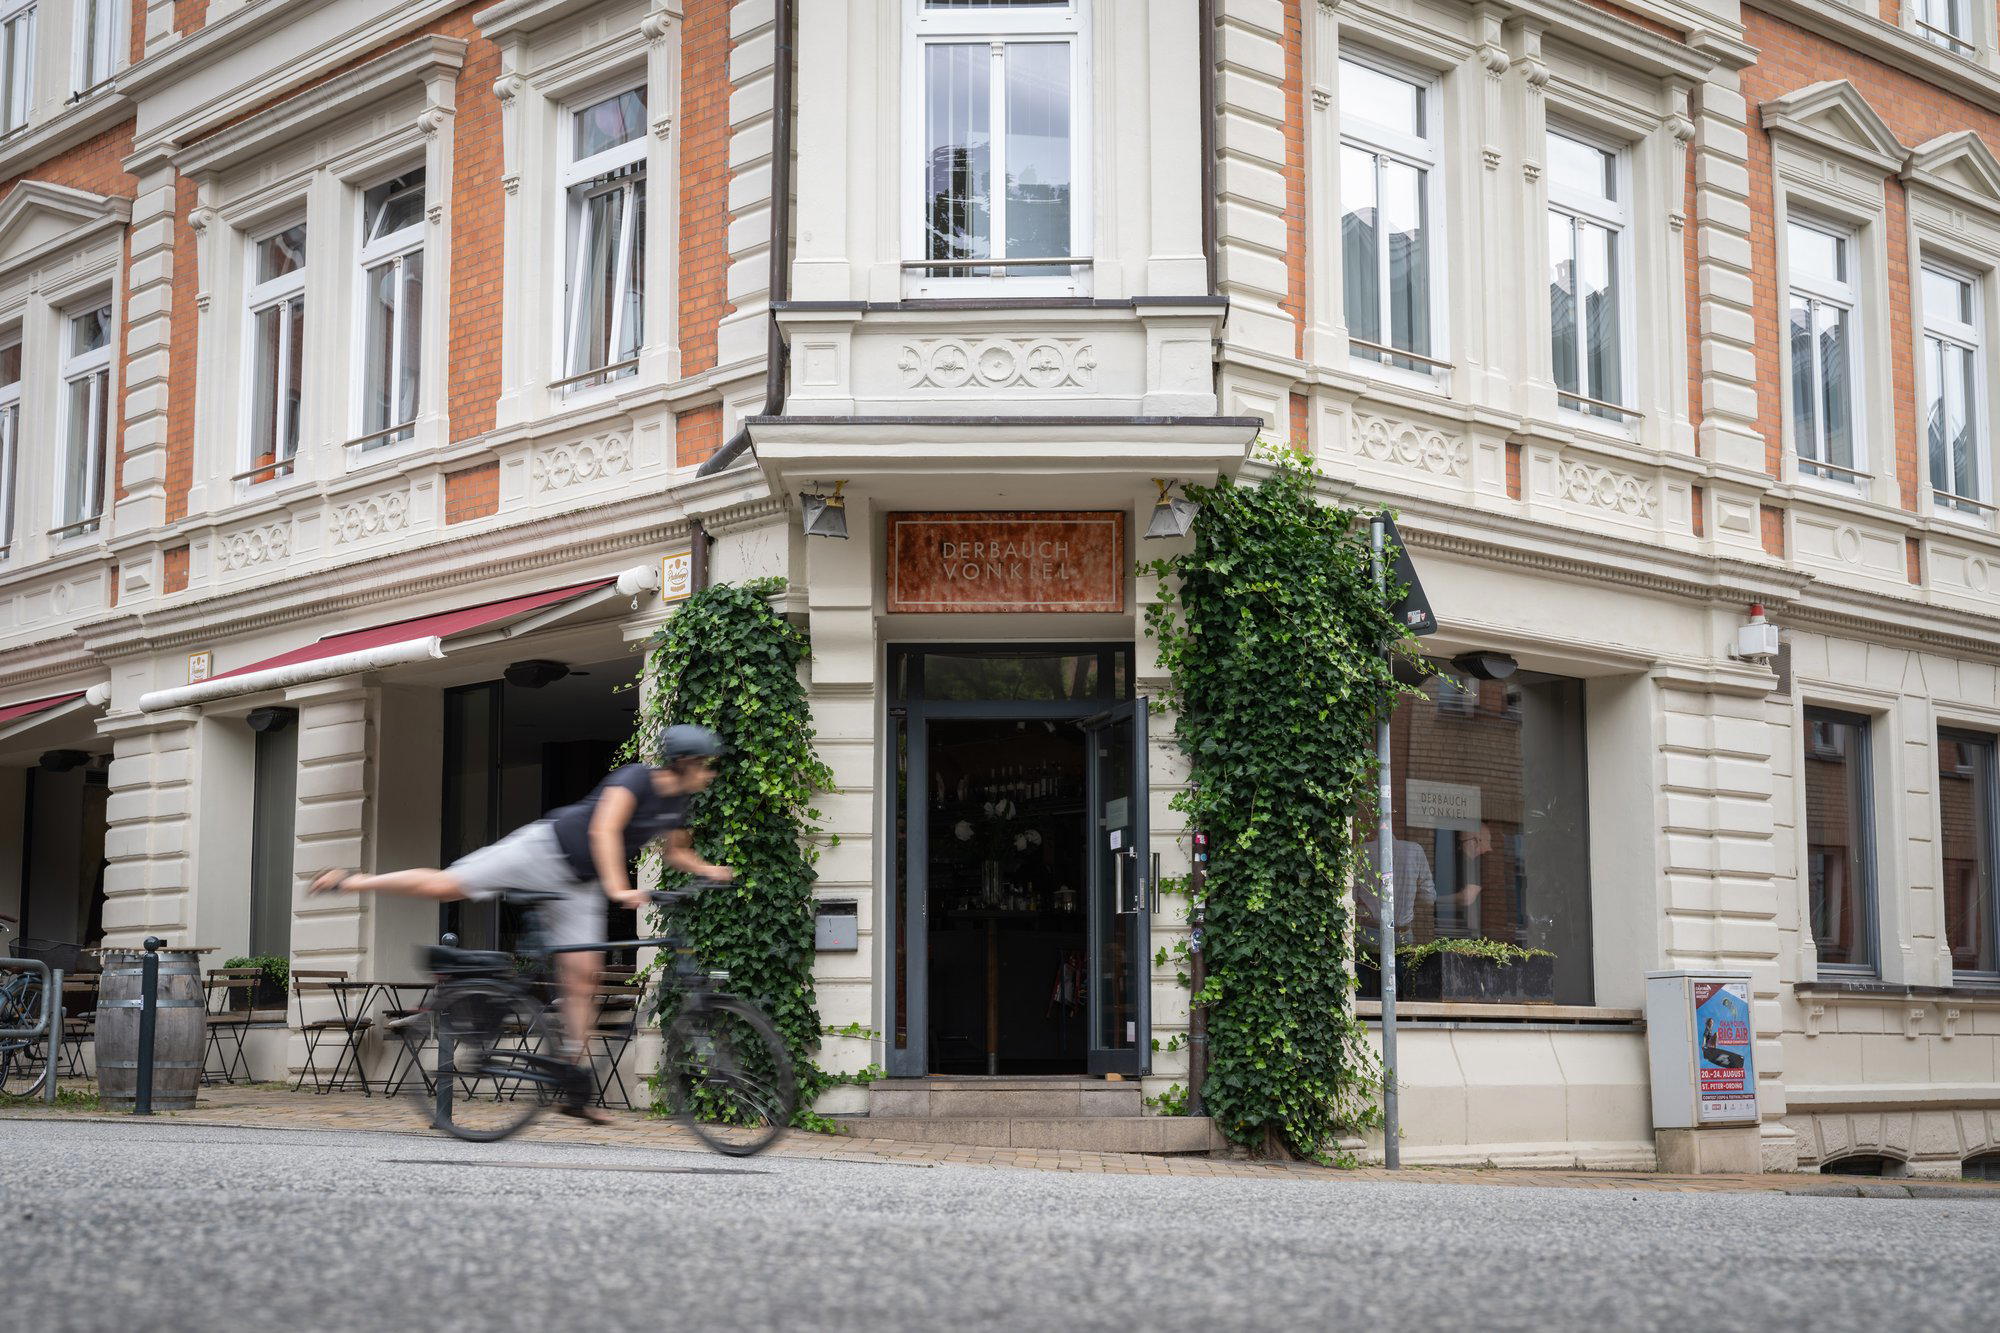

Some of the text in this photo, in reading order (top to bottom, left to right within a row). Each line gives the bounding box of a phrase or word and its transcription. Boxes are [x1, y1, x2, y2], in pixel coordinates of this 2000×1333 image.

[943, 542, 1069, 558] DERBAUCH
[943, 563, 1069, 580] VONKIEL
[1421, 792, 1467, 806] DERBAUCH
[1421, 806, 1467, 819] VONKIEL
[1718, 1028, 1748, 1040] BIG AIR
[1701, 1070, 1744, 1078] 20.-24. AUGUST
